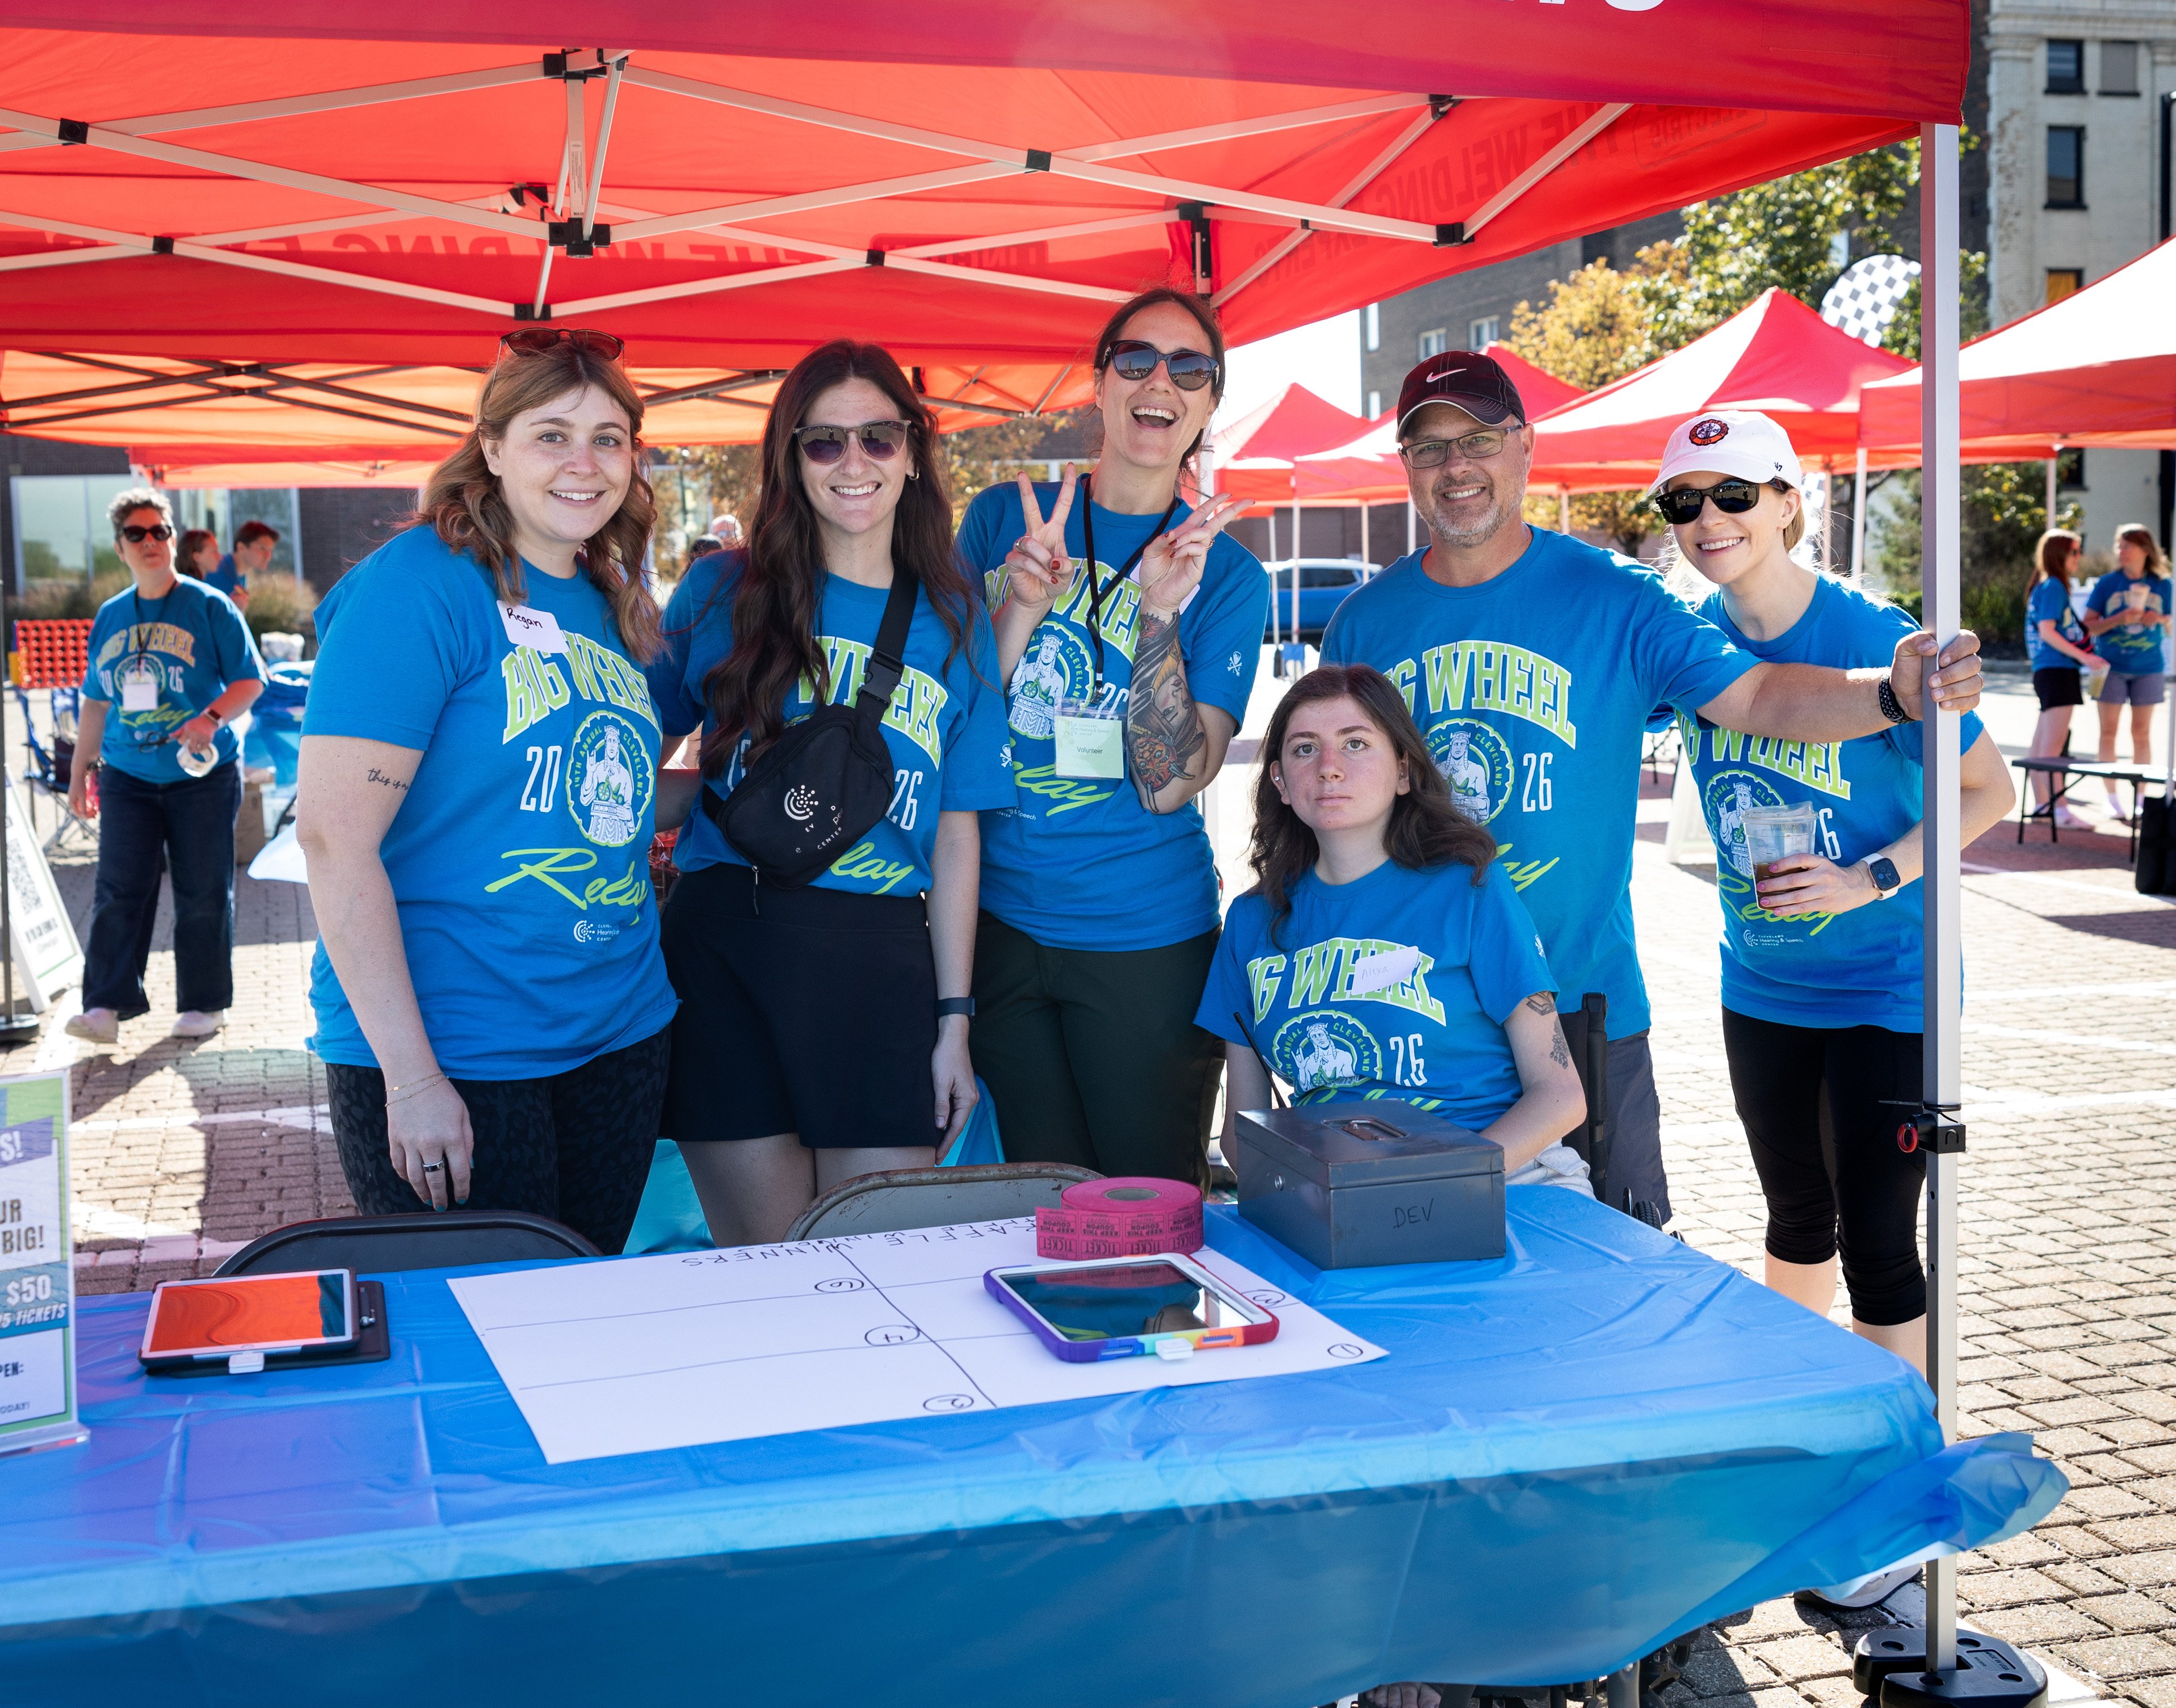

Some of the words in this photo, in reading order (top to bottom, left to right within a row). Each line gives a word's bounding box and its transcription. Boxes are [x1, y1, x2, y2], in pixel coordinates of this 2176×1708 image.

[506, 607, 543, 629] Regan
[501, 645, 571, 745] BIG
[1422, 640, 1576, 750] WHEEL
[579, 726, 602, 758] ANNUAL
[623, 733, 643, 796] CLEVELAND
[1475, 734, 1502, 786] CLEVELAND
[368, 768, 390, 786] this
[520, 746, 563, 813] 20
[1523, 752, 1554, 813] 26
[888, 769, 923, 831] 26
[1018, 810, 1036, 821] Speech
[817, 827, 842, 849] CENTER
[1818, 807, 1842, 860] 6
[829, 842, 914, 895] lay
[1284, 1028, 1302, 1059] ANNUAL
[1334, 1022, 1370, 1072] CLEVELAND
[1393, 1198, 1434, 1229] DEV
[2, 1225, 44, 1254] BIG!
[885, 1223, 1036, 1246] RAFFLE
[1043, 1238, 1073, 1252] TICKET
[1085, 1240, 1116, 1255] TICKET
[1130, 1240, 1161, 1255] TICKET
[681, 1243, 853, 1267] WINNERS
[6, 1274, 52, 1307] $50
[15, 1303, 68, 1326] TICKETS
